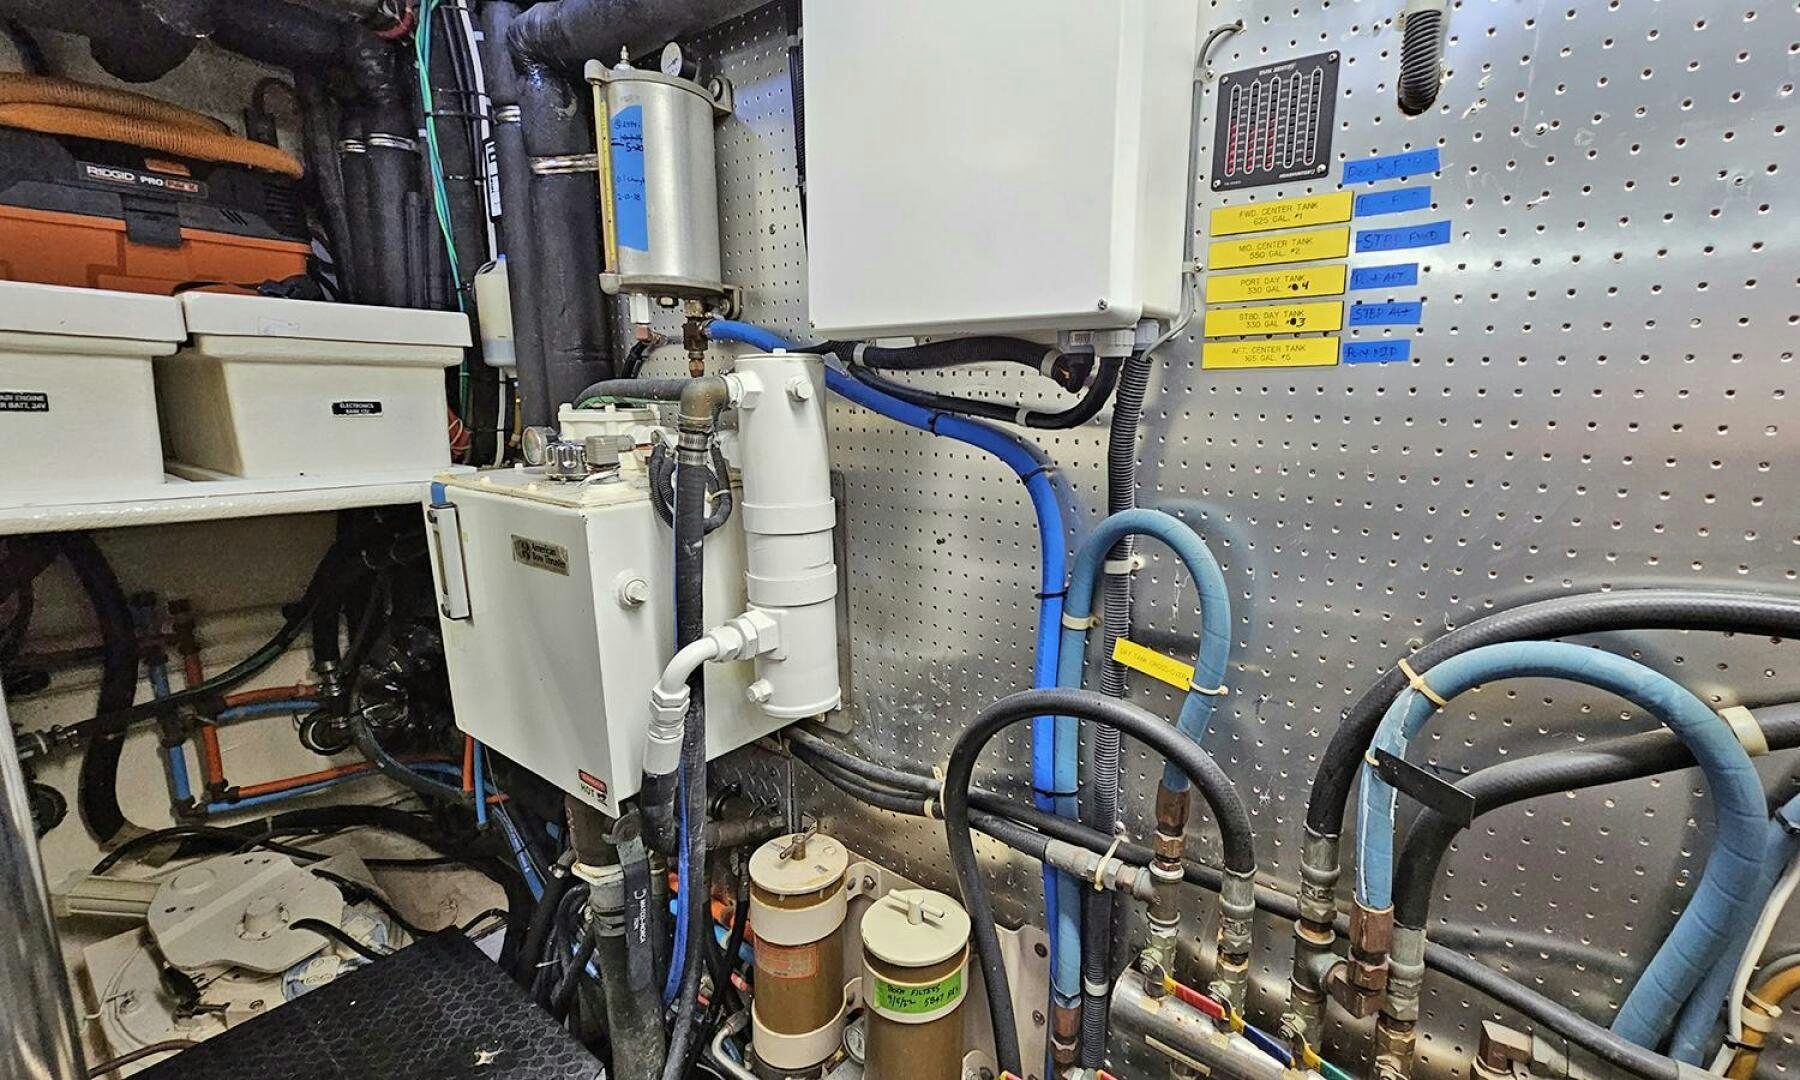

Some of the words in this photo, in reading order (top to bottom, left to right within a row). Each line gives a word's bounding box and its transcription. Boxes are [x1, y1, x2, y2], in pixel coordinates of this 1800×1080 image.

[86, 165, 136, 181] RIDGID
[139, 175, 164, 187] PRO
[1261, 204, 1293, 215] CENTER
[1297, 201, 1320, 211] TANK
[1256, 239, 1288, 251] CENTER
[1292, 237, 1314, 247] TANK
[1240, 277, 1261, 287] PORT
[1264, 275, 1280, 285] DAY
[1284, 274, 1305, 283] TANK
[1264, 310, 1280, 320] DAY
[1284, 309, 1305, 318] TANK
[1251, 345, 1282, 355] CENTER
[1285, 344, 1307, 354] TANK
